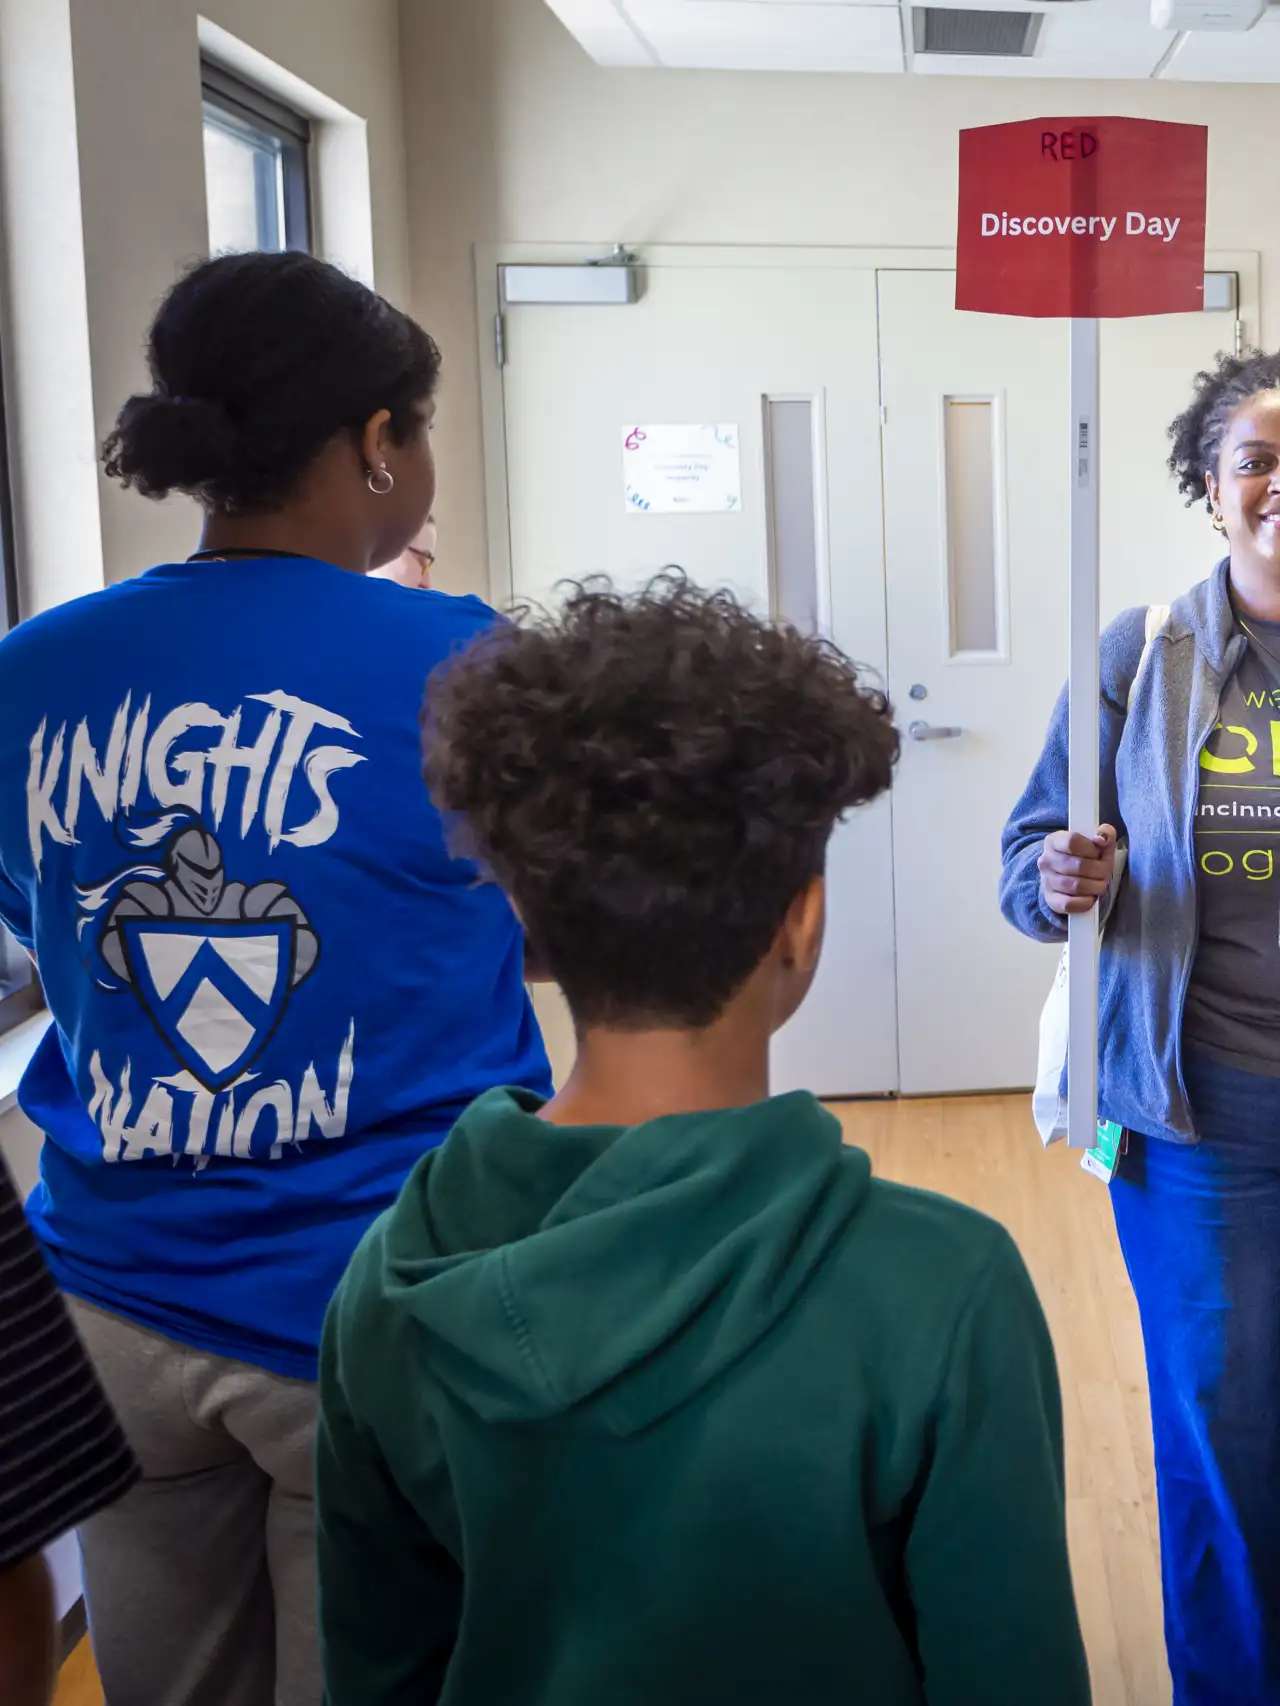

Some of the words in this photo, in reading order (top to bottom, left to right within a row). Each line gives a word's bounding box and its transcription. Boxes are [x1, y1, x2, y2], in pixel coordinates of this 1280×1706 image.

[1041, 131, 1098, 161] RED
[980, 213, 1117, 242] Discovery
[1125, 211, 1181, 242] Day
[26, 688, 369, 884] KNIGHTS
[88, 1016, 355, 1178] NATION
